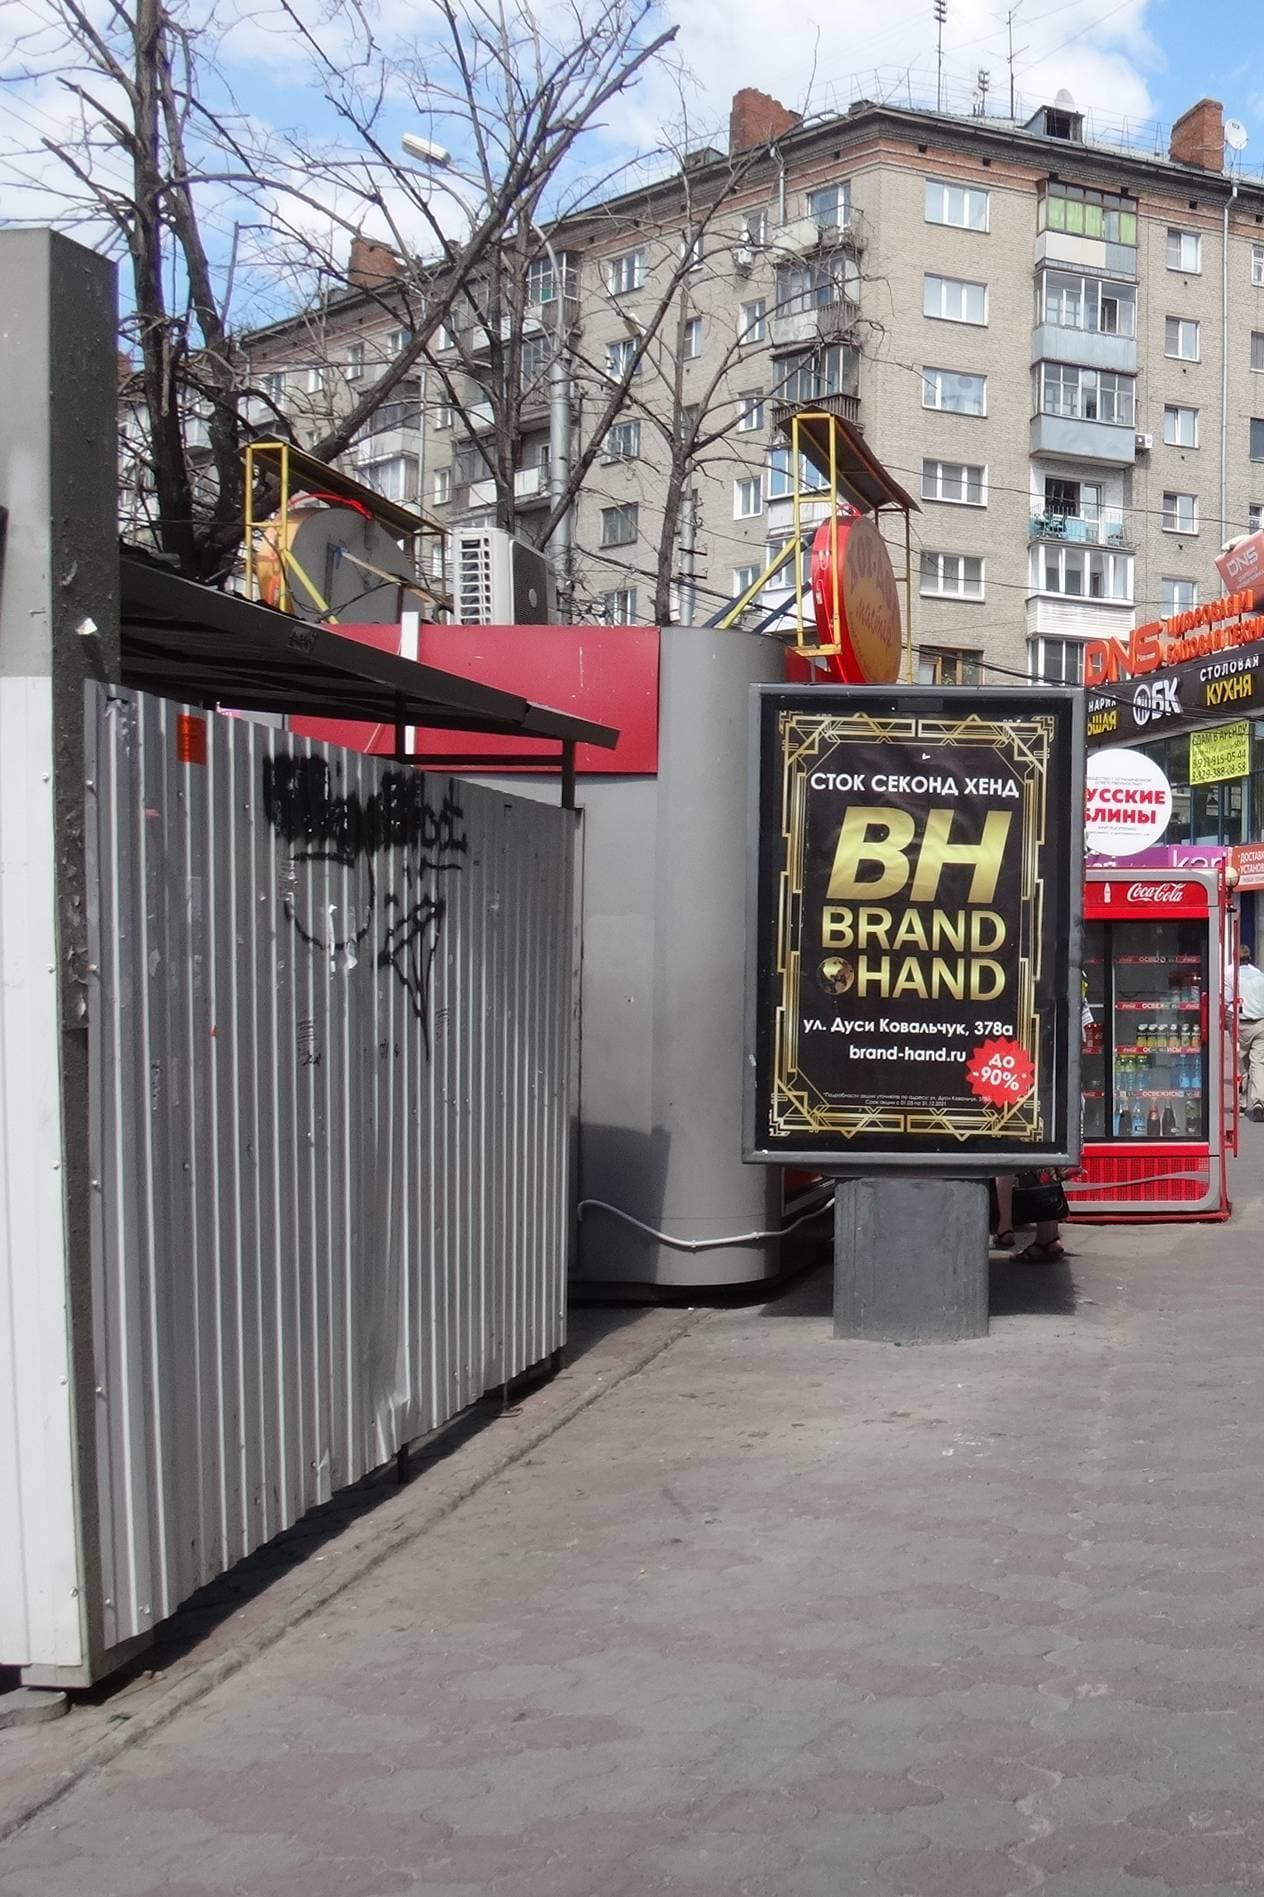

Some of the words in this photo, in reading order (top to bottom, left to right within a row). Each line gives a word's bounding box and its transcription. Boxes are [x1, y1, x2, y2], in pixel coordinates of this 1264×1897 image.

[1226, 546, 1259, 577] DNS
[1085, 622, 1165, 689] DNS
[1200, 655, 1260, 682] СТОЛОВАЯ
[1206, 674, 1252, 706] КУХНЯ
[811, 772, 865, 791] СТОК
[871, 775, 959, 796] СЕКОНД
[964, 778, 1019, 798] ХЕНД
[1085, 788, 1166, 804] УССКИЕ
[826, 806, 1013, 904] BH
[1173, 849, 1227, 867] kar
[822, 906, 1007, 953] BRAND
[857, 955, 1006, 1000] HAND
[803, 1019, 827, 1034] ул.
[831, 1017, 875, 1035] Дуси
[879, 1018, 970, 1038] Ковальчук,
[974, 1021, 1013, 1036] 378а
[849, 1045, 966, 1062] brand-hand.ru
